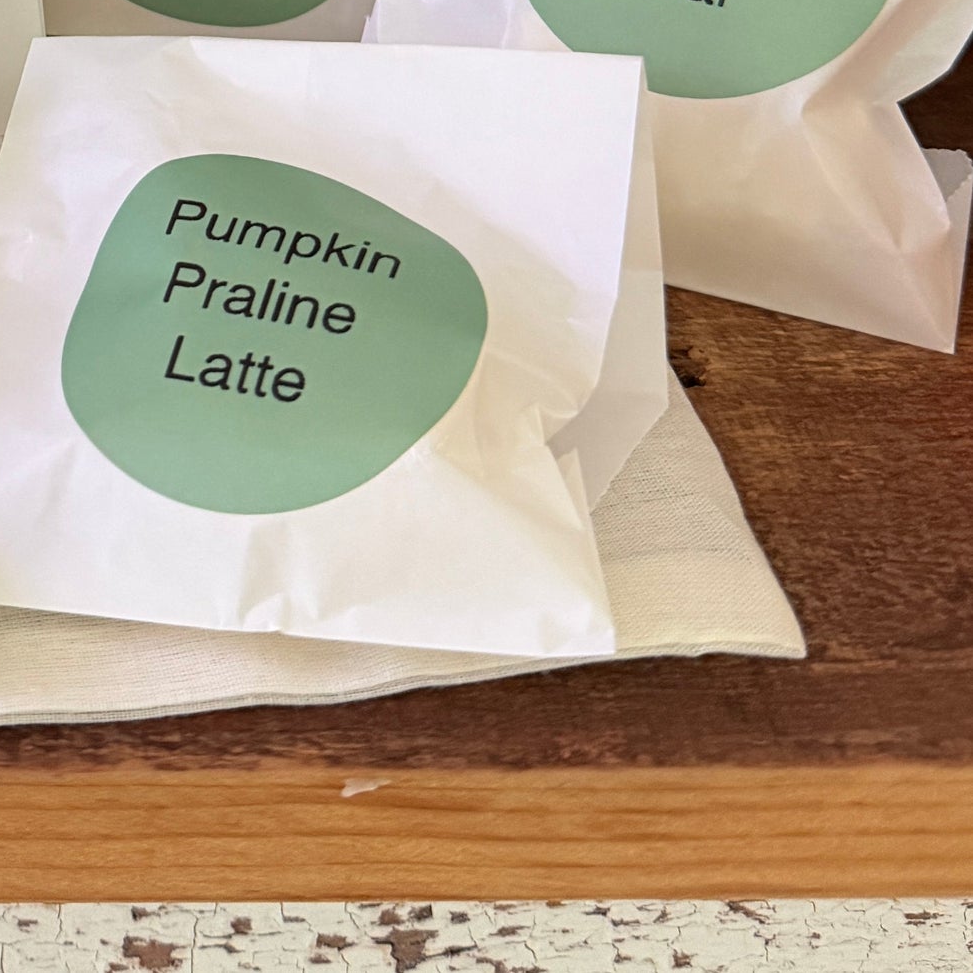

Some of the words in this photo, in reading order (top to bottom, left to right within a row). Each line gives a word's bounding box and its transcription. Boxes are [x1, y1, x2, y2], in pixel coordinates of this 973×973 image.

[164, 198, 402, 280] Pumpkin
[162, 260, 357, 336] Praline
[163, 334, 307, 404] Latte
